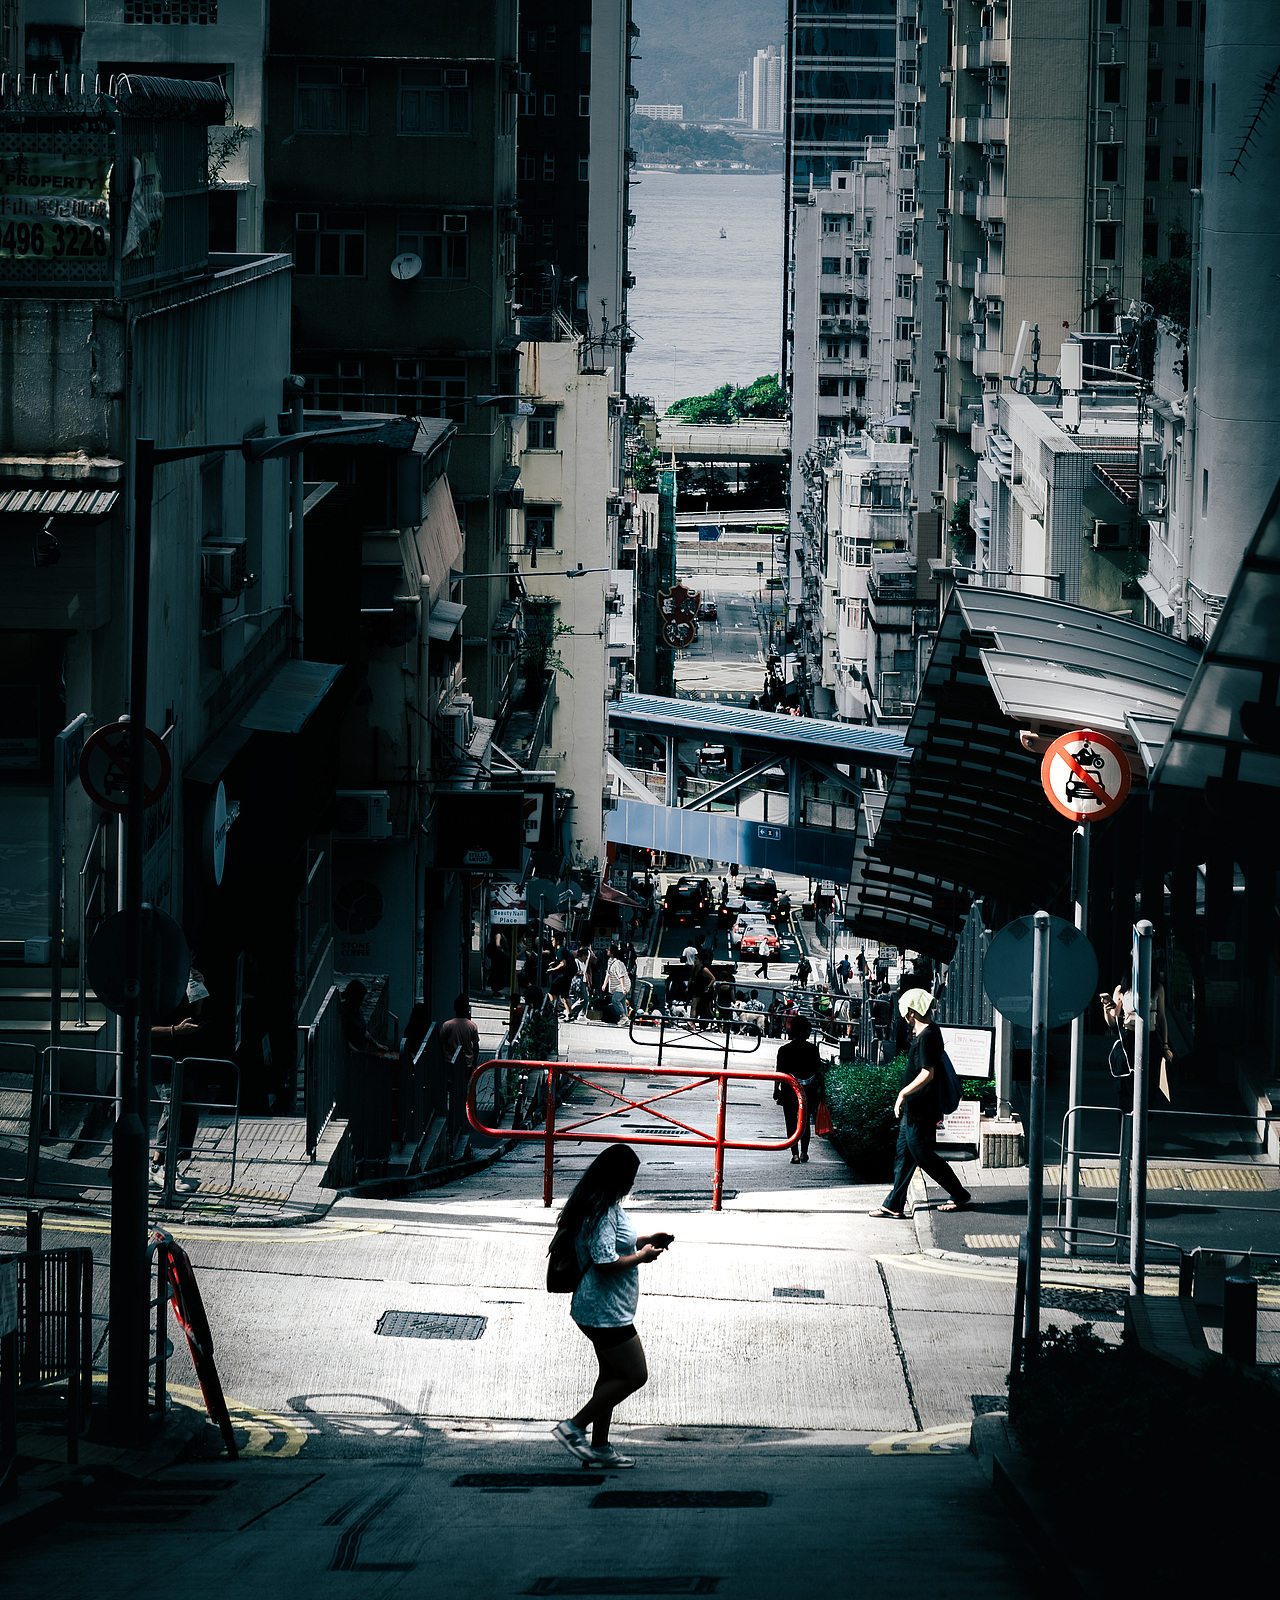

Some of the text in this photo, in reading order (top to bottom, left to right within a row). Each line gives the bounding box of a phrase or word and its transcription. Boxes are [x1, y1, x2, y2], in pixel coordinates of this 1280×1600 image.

[5, 173, 98, 190] PROPERTY
[0, 221, 45, 255] 496
[52, 223, 107, 256] 3228
[493, 909, 524, 918] Beauty Nail
